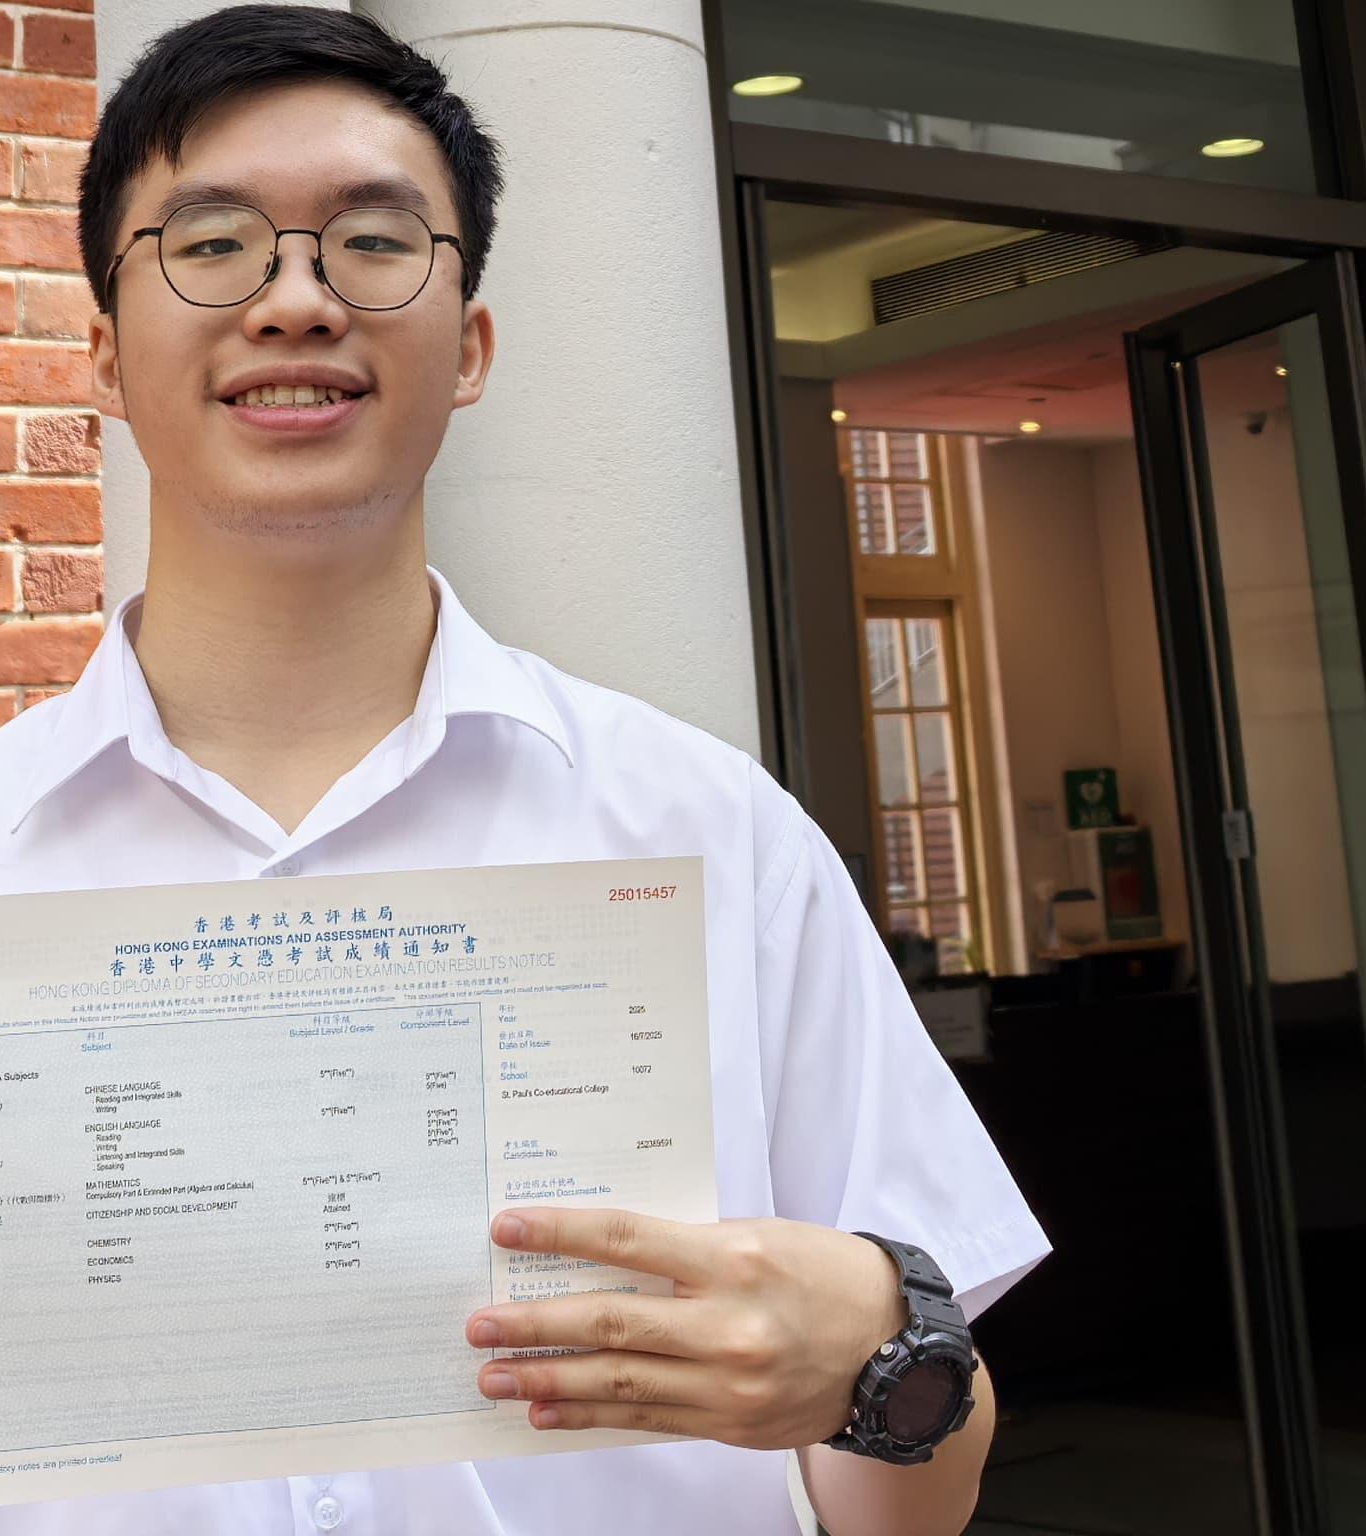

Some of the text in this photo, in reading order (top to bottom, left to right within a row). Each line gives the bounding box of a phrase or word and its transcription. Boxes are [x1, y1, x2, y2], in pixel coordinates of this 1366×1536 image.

[609, 886, 677, 901] 25015457
[194, 905, 393, 934] 香港考試及評核局
[115, 924, 466, 955] HONG KONG EXAMINATIONS AND ASSESSMENT AUTHORITY
[110, 935, 478, 977] 香港中學文憑考試成績通知書
[29, 952, 555, 1000] HONG KONG DIPLOMA OF SECONDARY EDUCATION EXAMINATION RESULTS NOTICE
[400, 1017, 470, 1031] Component Level
[498, 1015, 517, 1024] Year
[289, 1027, 318, 1039] Subject
[320, 1025, 343, 1036] Level
[349, 1023, 375, 1034] Grade
[81, 1042, 112, 1054] Subject
[499, 1041, 518, 1050] Date
[4, 1071, 39, 1082] Subjects
[500, 1071, 528, 1081] School
[85, 1081, 161, 1095] CHINESE LANGUAGE
[96, 1090, 182, 1105] Reading and Integrated Skills
[96, 1105, 117, 1114] Writing
[85, 1119, 161, 1133] ENGLISH LANGUAGE
[96, 1133, 121, 1142] Reading
[96, 1143, 117, 1152] Writing
[96, 1148, 185, 1162] Listening and Integrated Skills
[96, 1162, 125, 1172] Speaking
[86, 1178, 141, 1190] MATHEMATICS
[86, 1191, 122, 1201] Compulsory
[123, 1189, 136, 1198] Part
[143, 1187, 172, 1197] Extended
[173, 1185, 186, 1194] Part
[187, 1184, 212, 1195] (Algebra
[214, 1182, 225, 1191] and
[226, 1180, 255, 1191] Calculus)
[557, 1186, 597, 1197] Document
[86, 1201, 238, 1220] CITIZENSHIP AND SOCIAL DEVELOPMENT
[323, 1203, 351, 1213] Attained
[87, 1237, 132, 1248] CHEMISTRY
[87, 1255, 134, 1266] ECONOMICS
[88, 1274, 122, 1285] PHYSICS
[18, 1462, 40, 1472] notes
[43, 1460, 56, 1469] are
[58, 1457, 87, 1470] printed
[89, 1454, 123, 1465] overleaf
